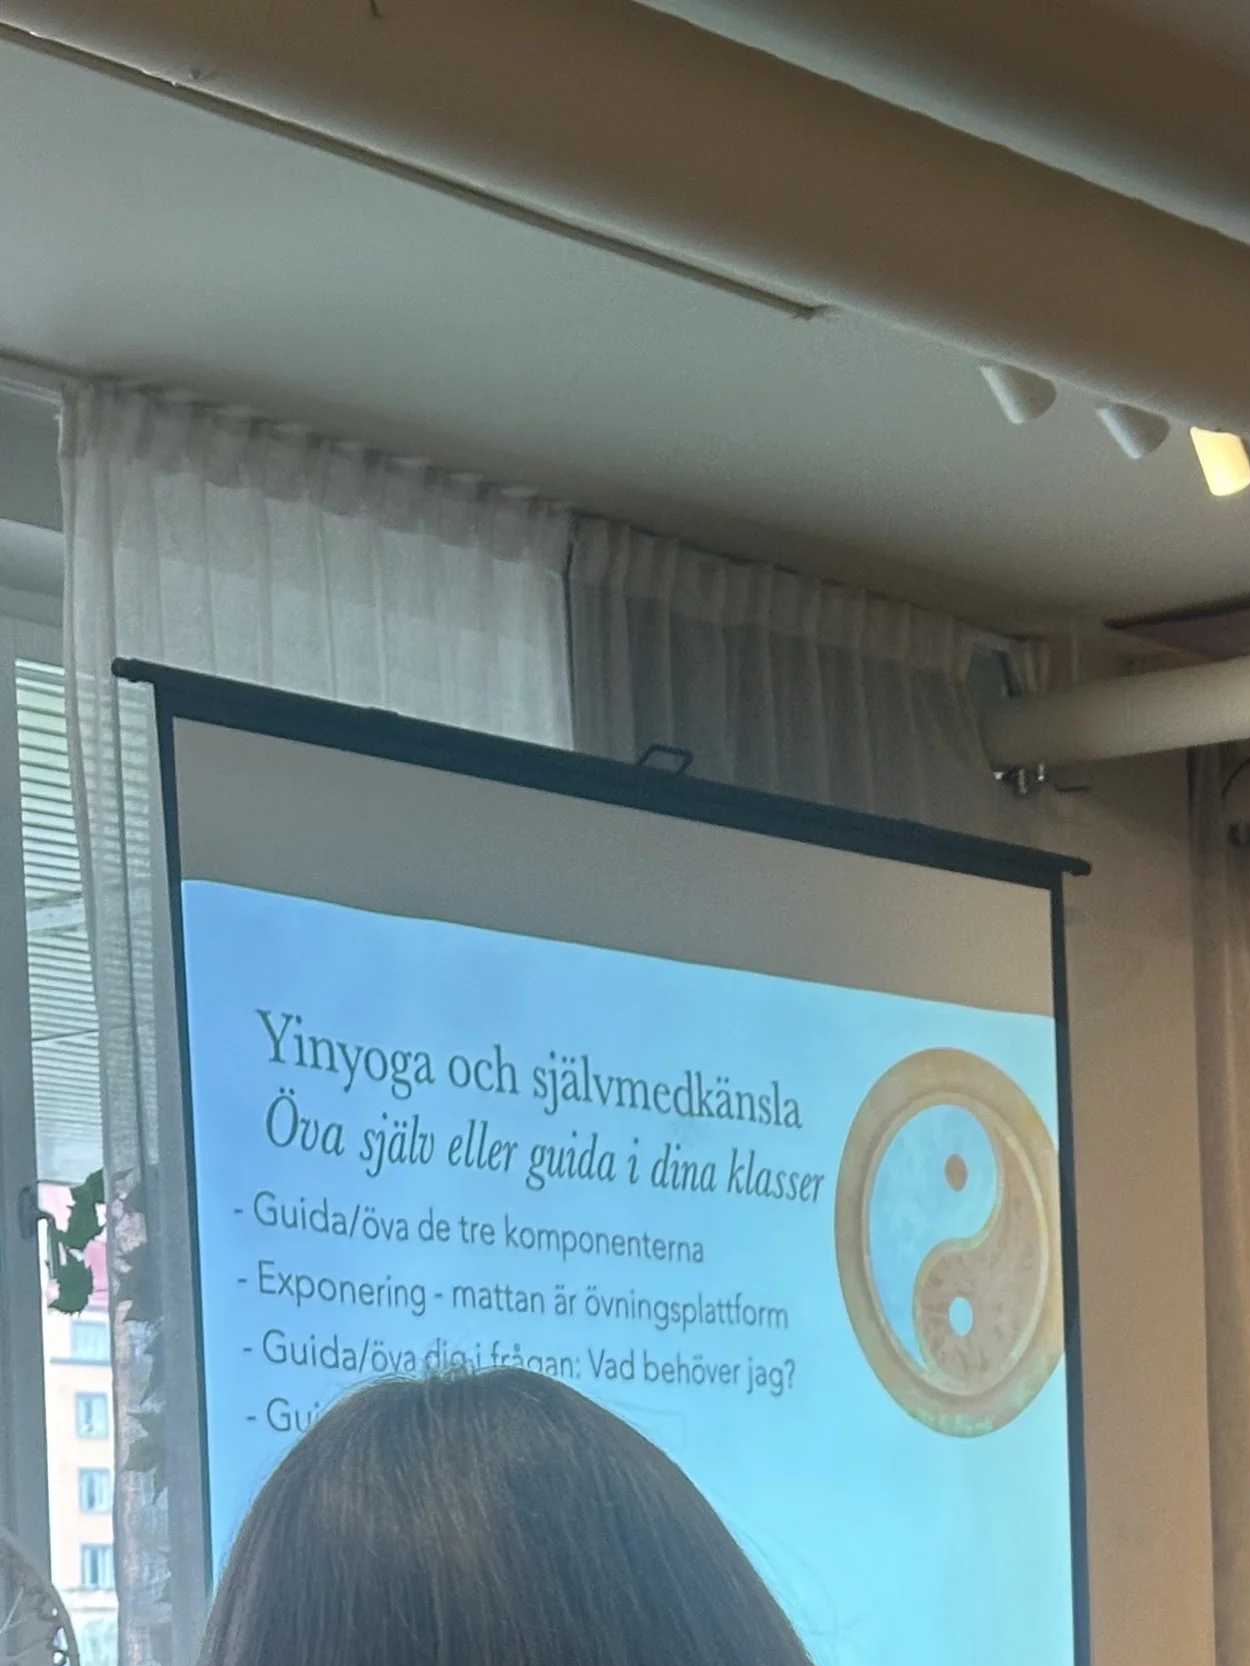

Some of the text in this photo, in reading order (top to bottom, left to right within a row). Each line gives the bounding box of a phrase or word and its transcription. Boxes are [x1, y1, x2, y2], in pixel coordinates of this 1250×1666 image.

[255, 1008, 803, 1129] Yinyoga och självmedkänsla
[265, 1086, 826, 1204] Öva själv eller guida i dina klasser
[253, 1189, 409, 1242] Guida/öva
[418, 1206, 451, 1243] de
[459, 1214, 496, 1246] tre
[505, 1212, 705, 1263] komponenterna
[258, 1259, 427, 1317] Exponering
[452, 1282, 545, 1314] mattan
[554, 1284, 578, 1317] är
[585, 1284, 790, 1332] övningsplattform
[262, 1328, 417, 1374] Guida/öva
[588, 1348, 636, 1381] Vad
[643, 1349, 742, 1386] behöver
[746, 1356, 797, 1397] jag?
